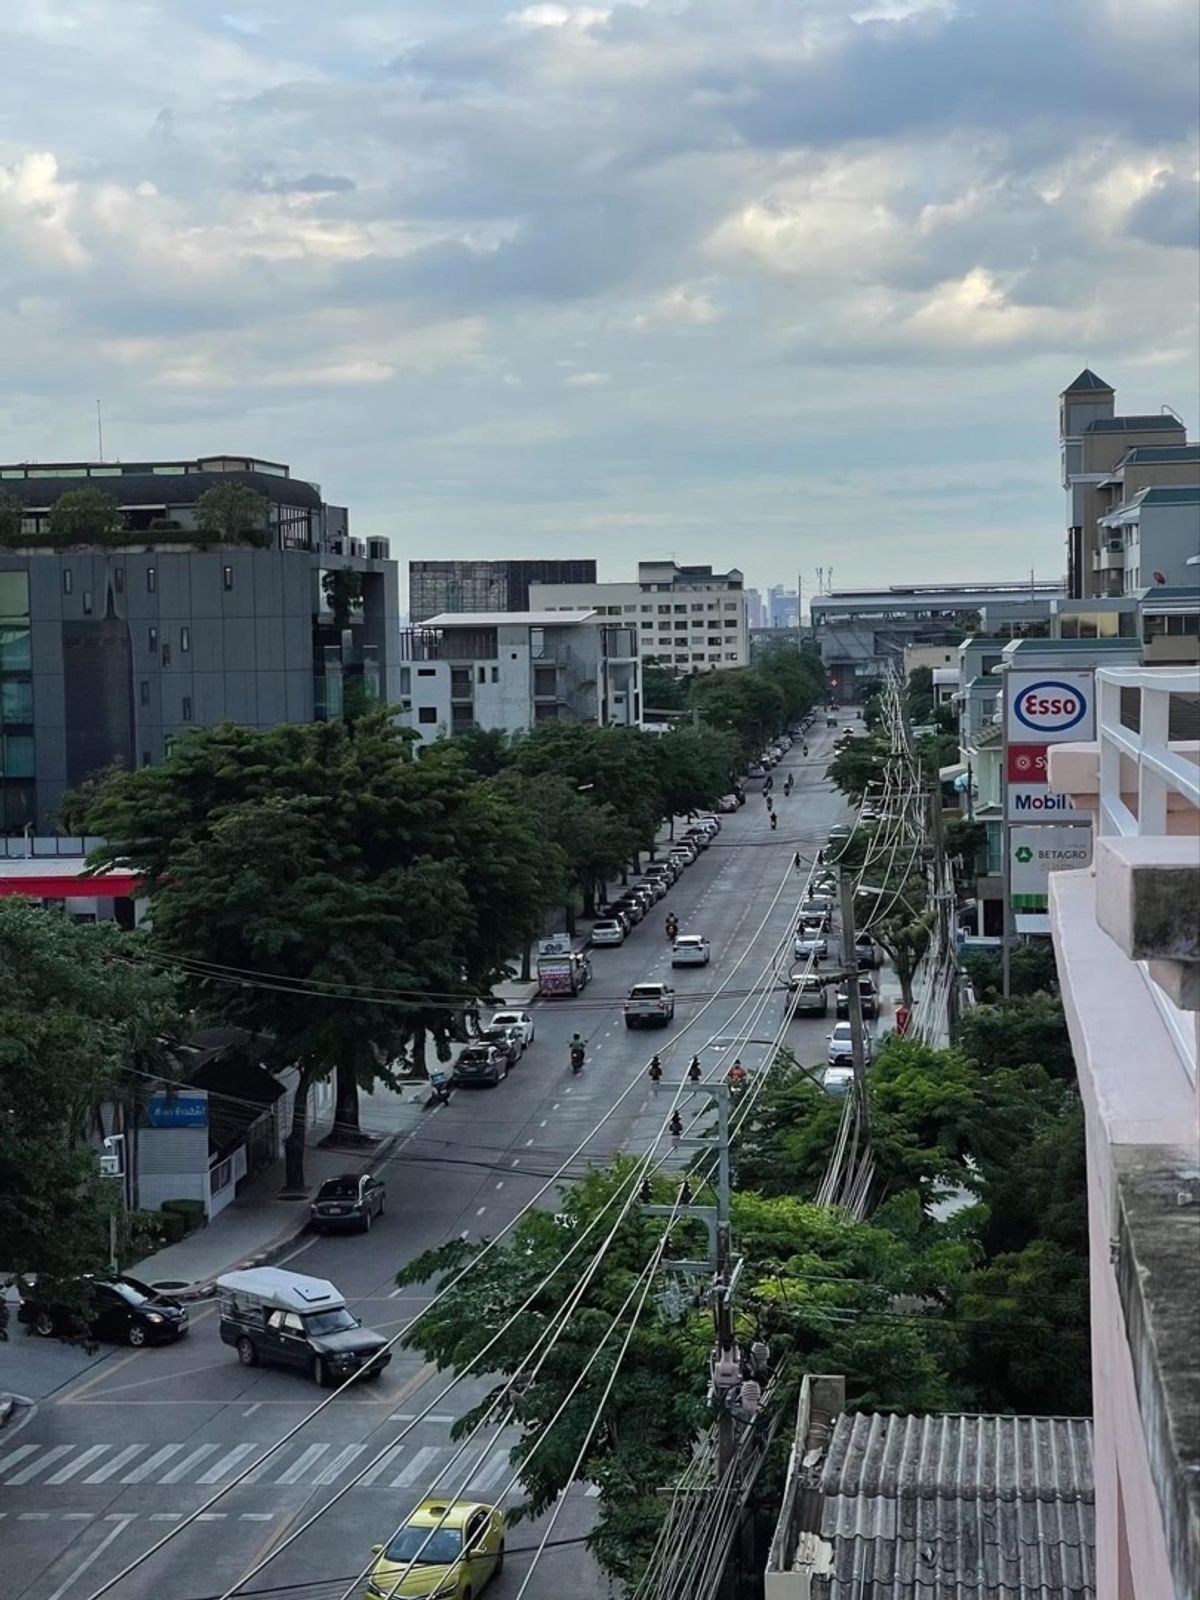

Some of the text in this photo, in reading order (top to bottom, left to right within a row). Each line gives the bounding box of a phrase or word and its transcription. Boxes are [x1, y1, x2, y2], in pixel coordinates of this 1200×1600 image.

[1025, 694, 1077, 716] Esso
[1015, 794, 1067, 810] Mobil
[1038, 850, 1087, 859] BETAGRO
